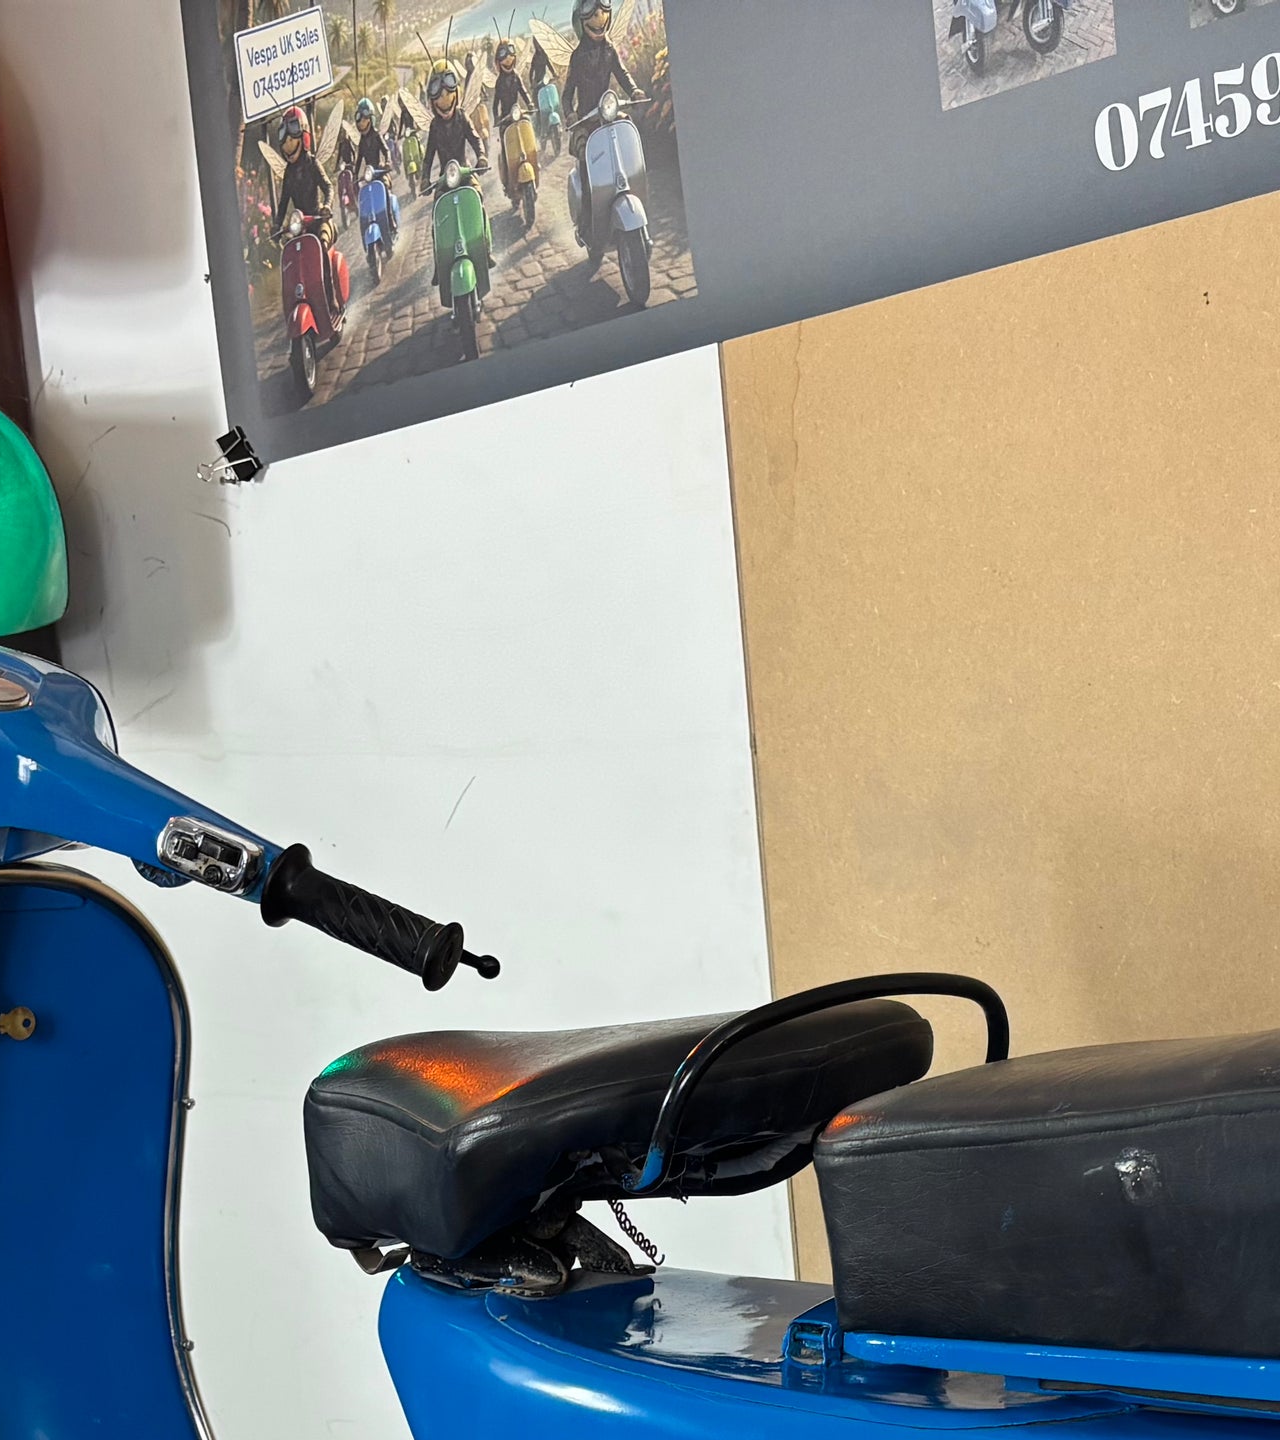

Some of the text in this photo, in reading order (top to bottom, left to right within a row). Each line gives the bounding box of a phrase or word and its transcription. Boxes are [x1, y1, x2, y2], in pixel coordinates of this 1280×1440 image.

[246, 27, 320, 67] Vespa UK Sales
